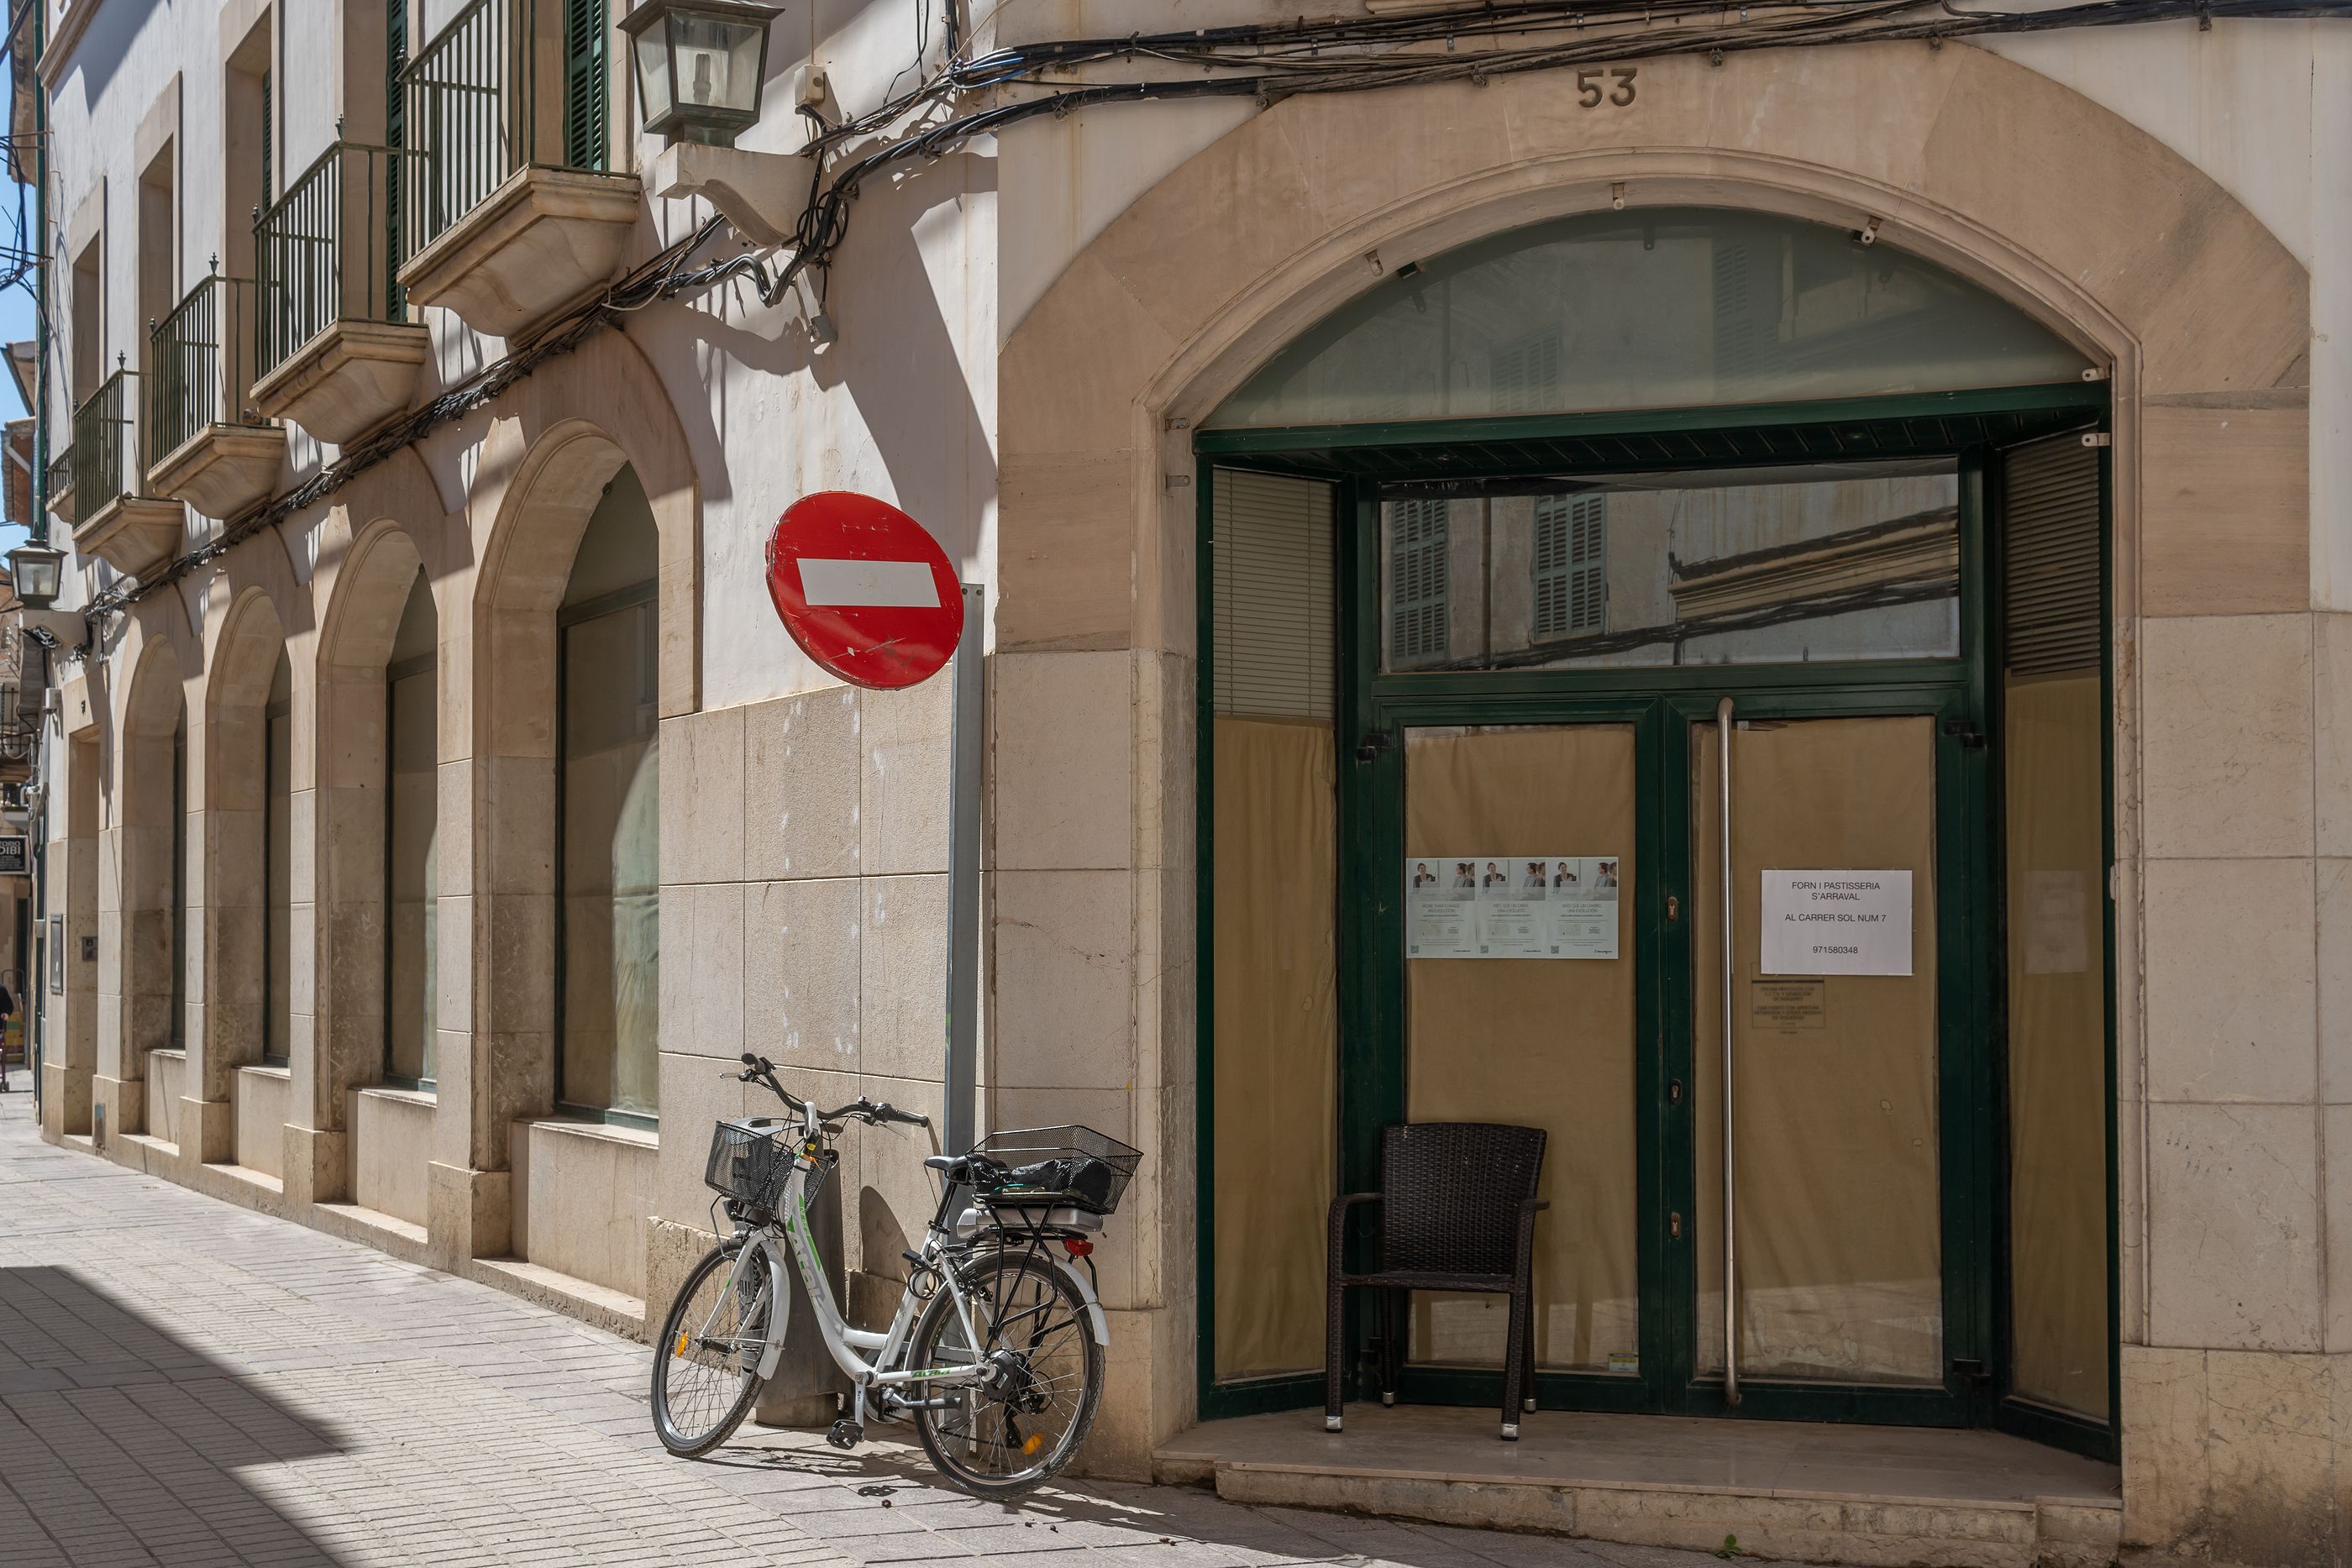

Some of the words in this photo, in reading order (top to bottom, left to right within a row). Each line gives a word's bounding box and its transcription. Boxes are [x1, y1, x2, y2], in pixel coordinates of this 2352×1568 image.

[1577, 67, 1637, 108] 53
[1792, 881, 1816, 890] FORN
[1824, 882, 1881, 890] PASTISSERIA
[1811, 892, 1861, 901] S'ARRAVAL
[1798, 913, 1835, 922] CARRER
[1837, 914, 1856, 922] SOL
[1857, 914, 1879, 923] NUM
[1881, 914, 1887, 922] 7
[1812, 946, 1859, 955] 971580348
